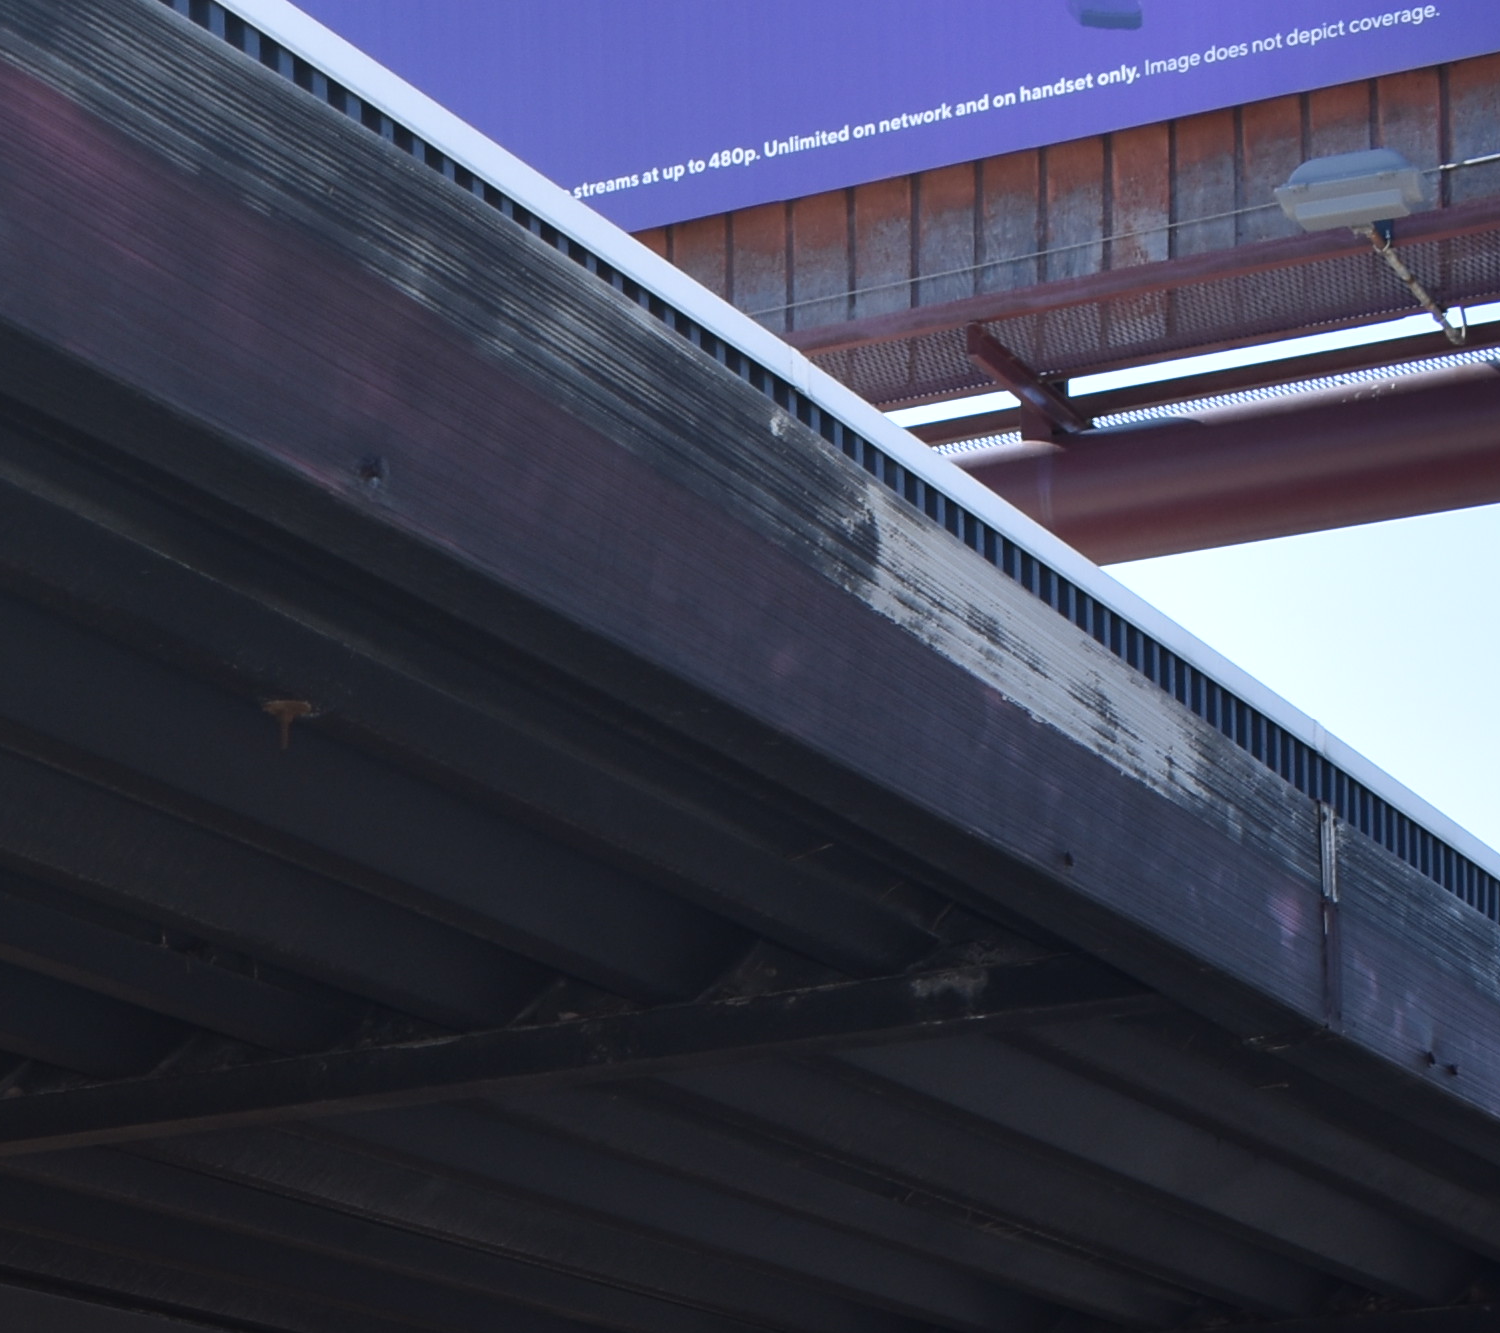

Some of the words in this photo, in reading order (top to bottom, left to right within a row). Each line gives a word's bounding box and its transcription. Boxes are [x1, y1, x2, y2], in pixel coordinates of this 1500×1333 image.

[573, 174, 639, 199] streams
[642, 168, 658, 184] at
[662, 163, 684, 185] up
[687, 158, 705, 173] to
[708, 146, 761, 172] 480p.
[764, 126, 849, 157] Unlimited
[853, 121, 875, 138] on
[879, 103, 952, 133] network
[955, 95, 989, 119] and
[993, 91, 1016, 107] on
[1019, 73, 1093, 103] handset
[1097, 64, 1141, 87] only.
[1145, 50, 1200, 76] Image
[1203, 41, 1248, 63] does
[1251, 33, 1283, 54] not
[1286, 20, 1345, 47] depict
[1349, 4, 1440, 33] coverage.
